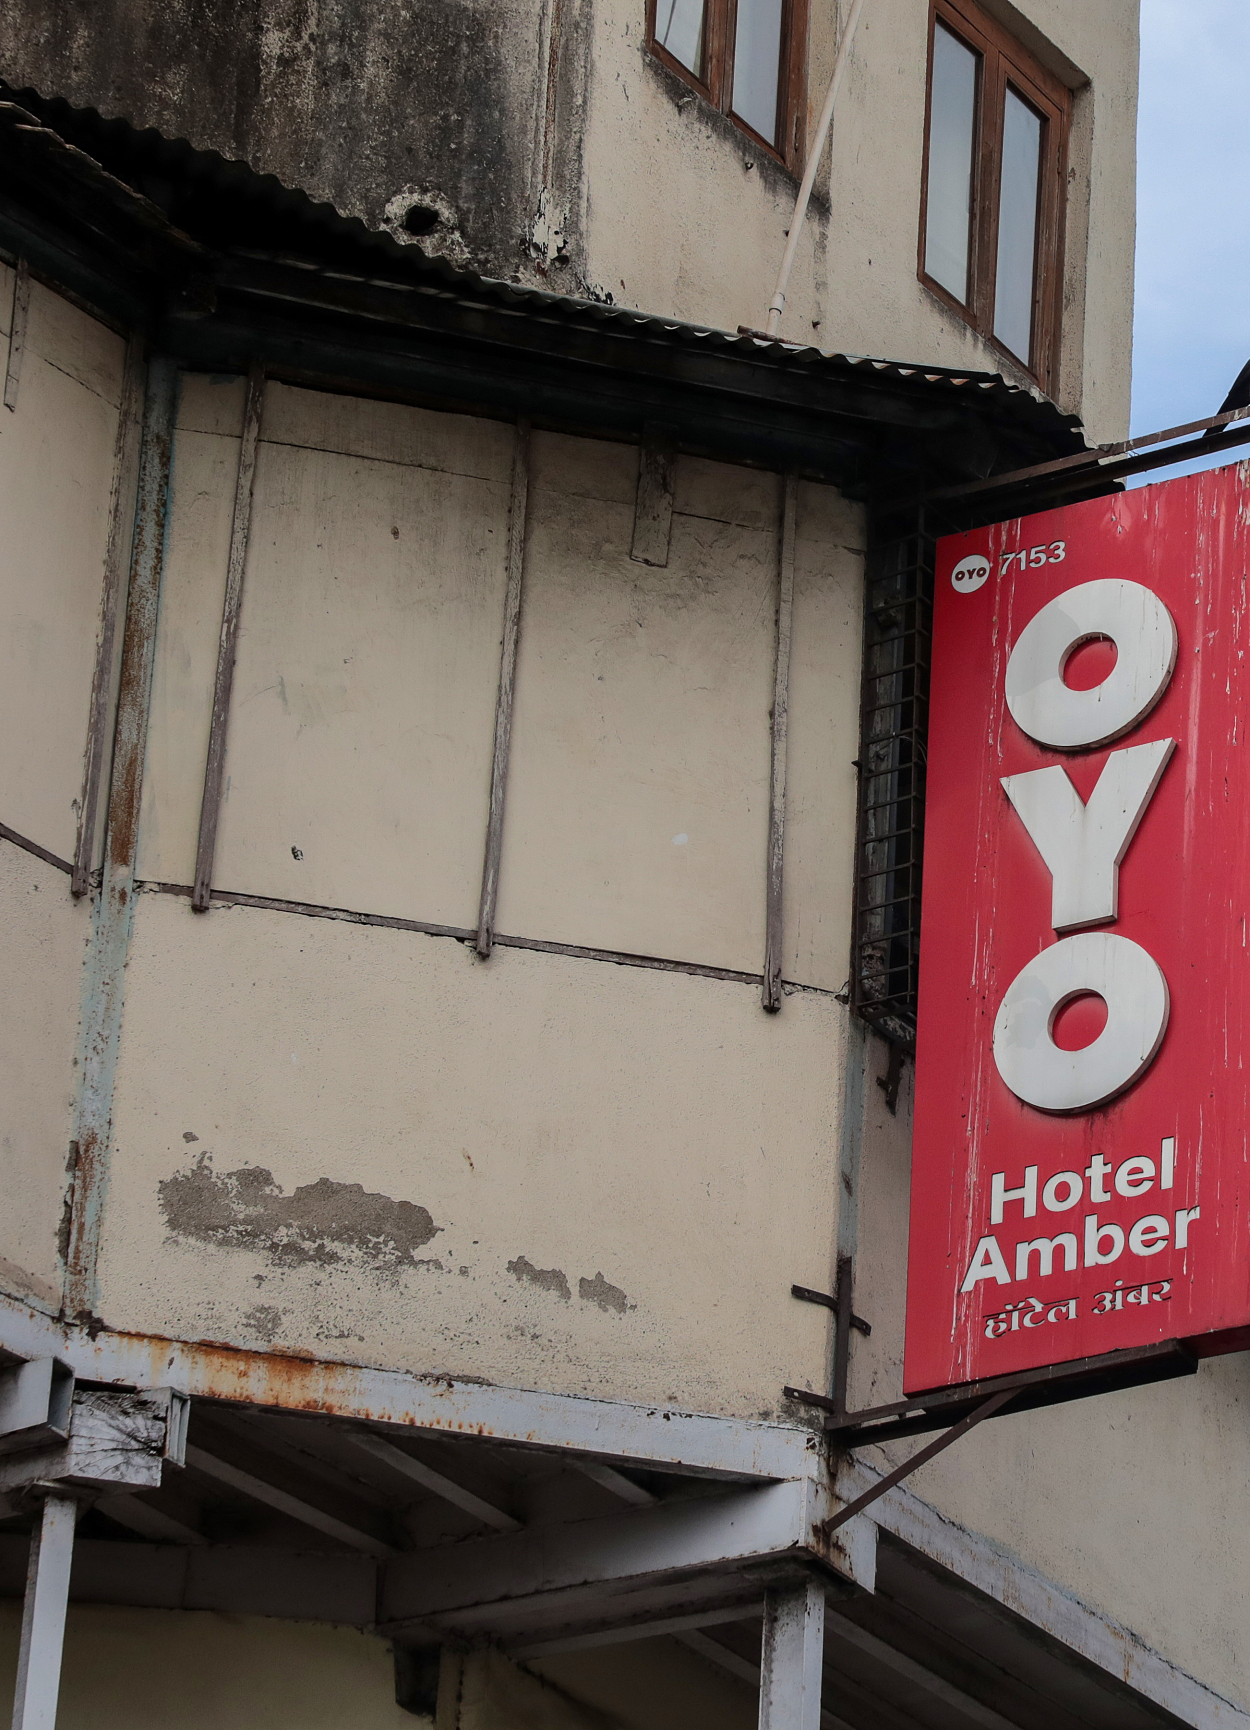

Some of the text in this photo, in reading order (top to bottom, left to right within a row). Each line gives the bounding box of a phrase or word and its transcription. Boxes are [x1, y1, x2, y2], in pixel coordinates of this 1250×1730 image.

[955, 540, 1066, 582] OYO 7153
[993, 578, 1179, 1115] OYO
[990, 1136, 1175, 1225] Hotel
[959, 1205, 1200, 1293] Amber
[983, 1279, 1174, 1339] हॉटेल अंबर
